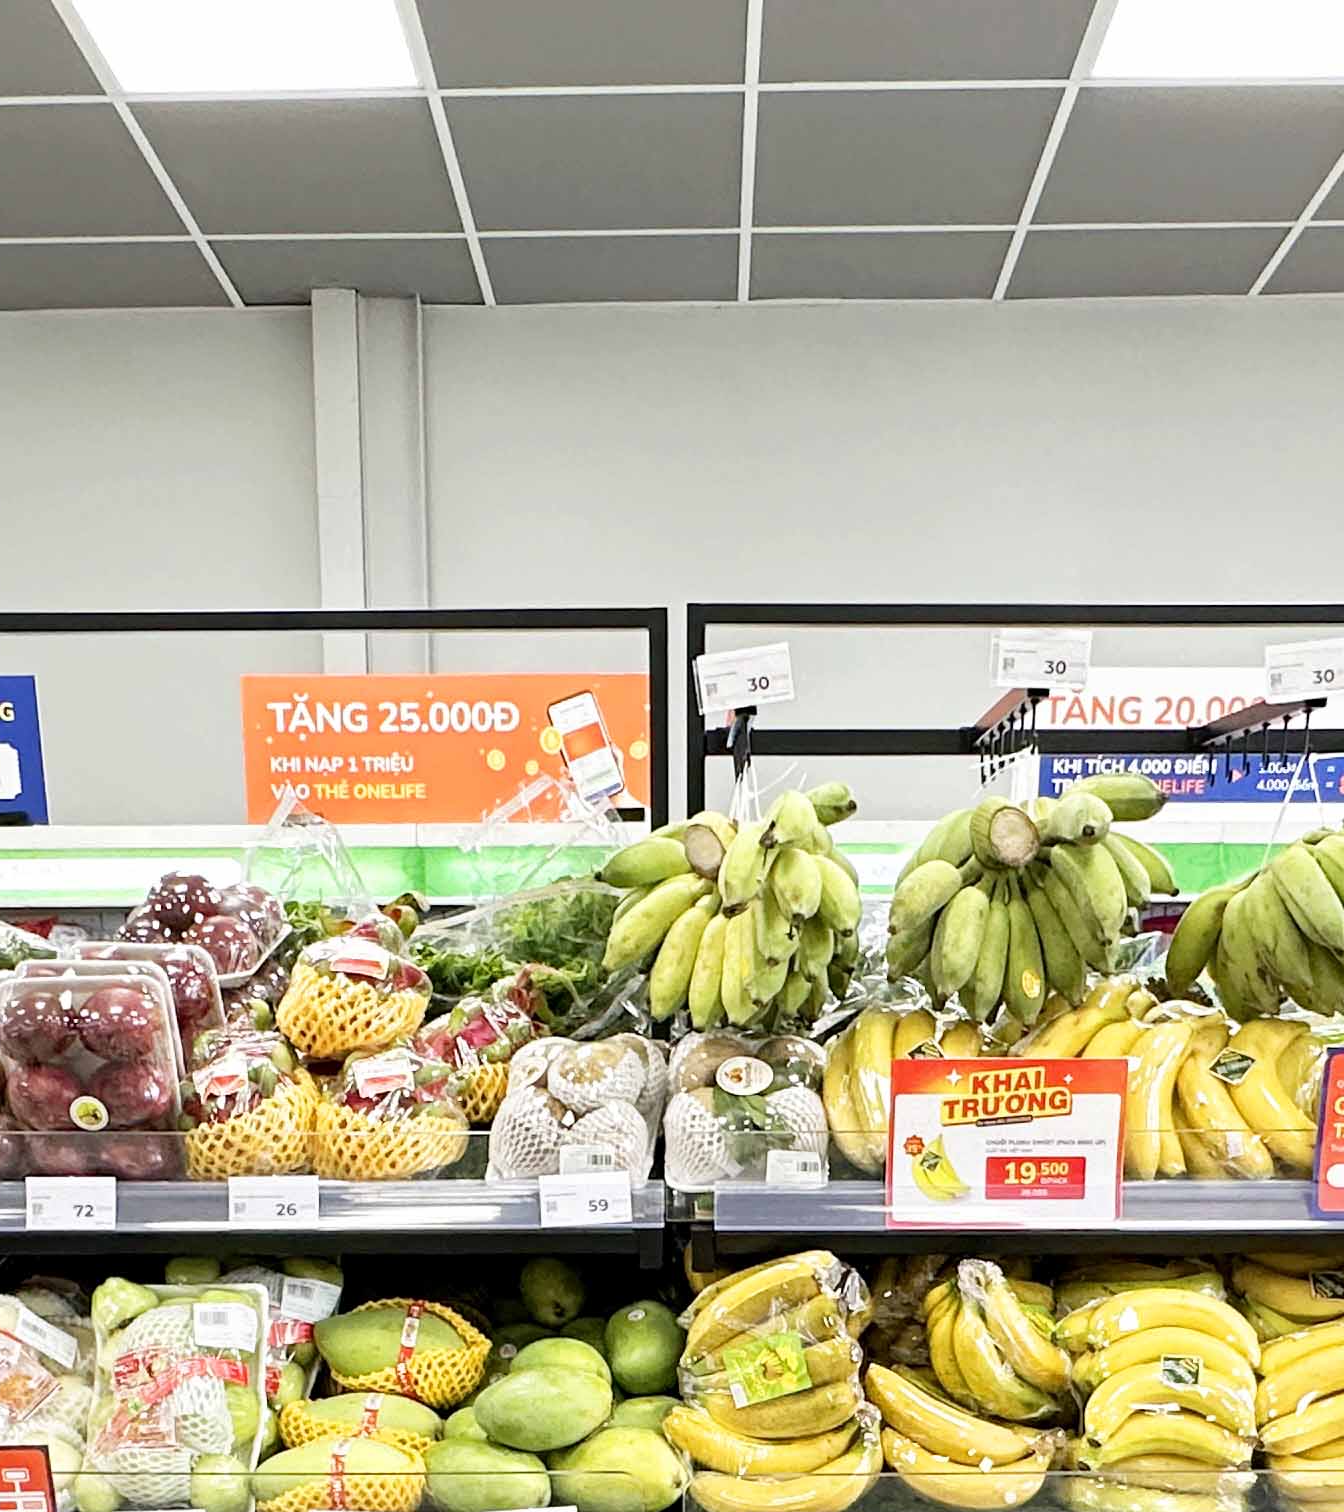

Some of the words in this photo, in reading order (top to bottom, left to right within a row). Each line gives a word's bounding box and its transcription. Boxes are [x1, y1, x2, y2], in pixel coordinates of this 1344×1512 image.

[1043, 660, 1067, 675] 30
[1312, 669, 1335, 685] 30
[747, 676, 770, 692] 30
[267, 693, 369, 741] TẶNG
[379, 701, 520, 733] 25.000Đ
[270, 756, 300, 773] KHI
[305, 756, 343, 777] NẠP
[348, 757, 357, 772] 1
[362, 751, 414, 776] TRIỆU
[1053, 758, 1083, 774] KHI
[1085, 754, 1125, 774] TÍCH
[1128, 758, 1171, 775] 4.000
[314, 779, 349, 799] THẺ
[353, 783, 426, 799] ONELIFE
[973, 1071, 1042, 1095] KHAI
[943, 1090, 1070, 1120] TRƯƠNG
[1004, 1161, 1037, 1185] 19
[73, 1204, 94, 1218] 72
[276, 1203, 297, 1216] 26
[588, 1199, 609, 1212] 59
